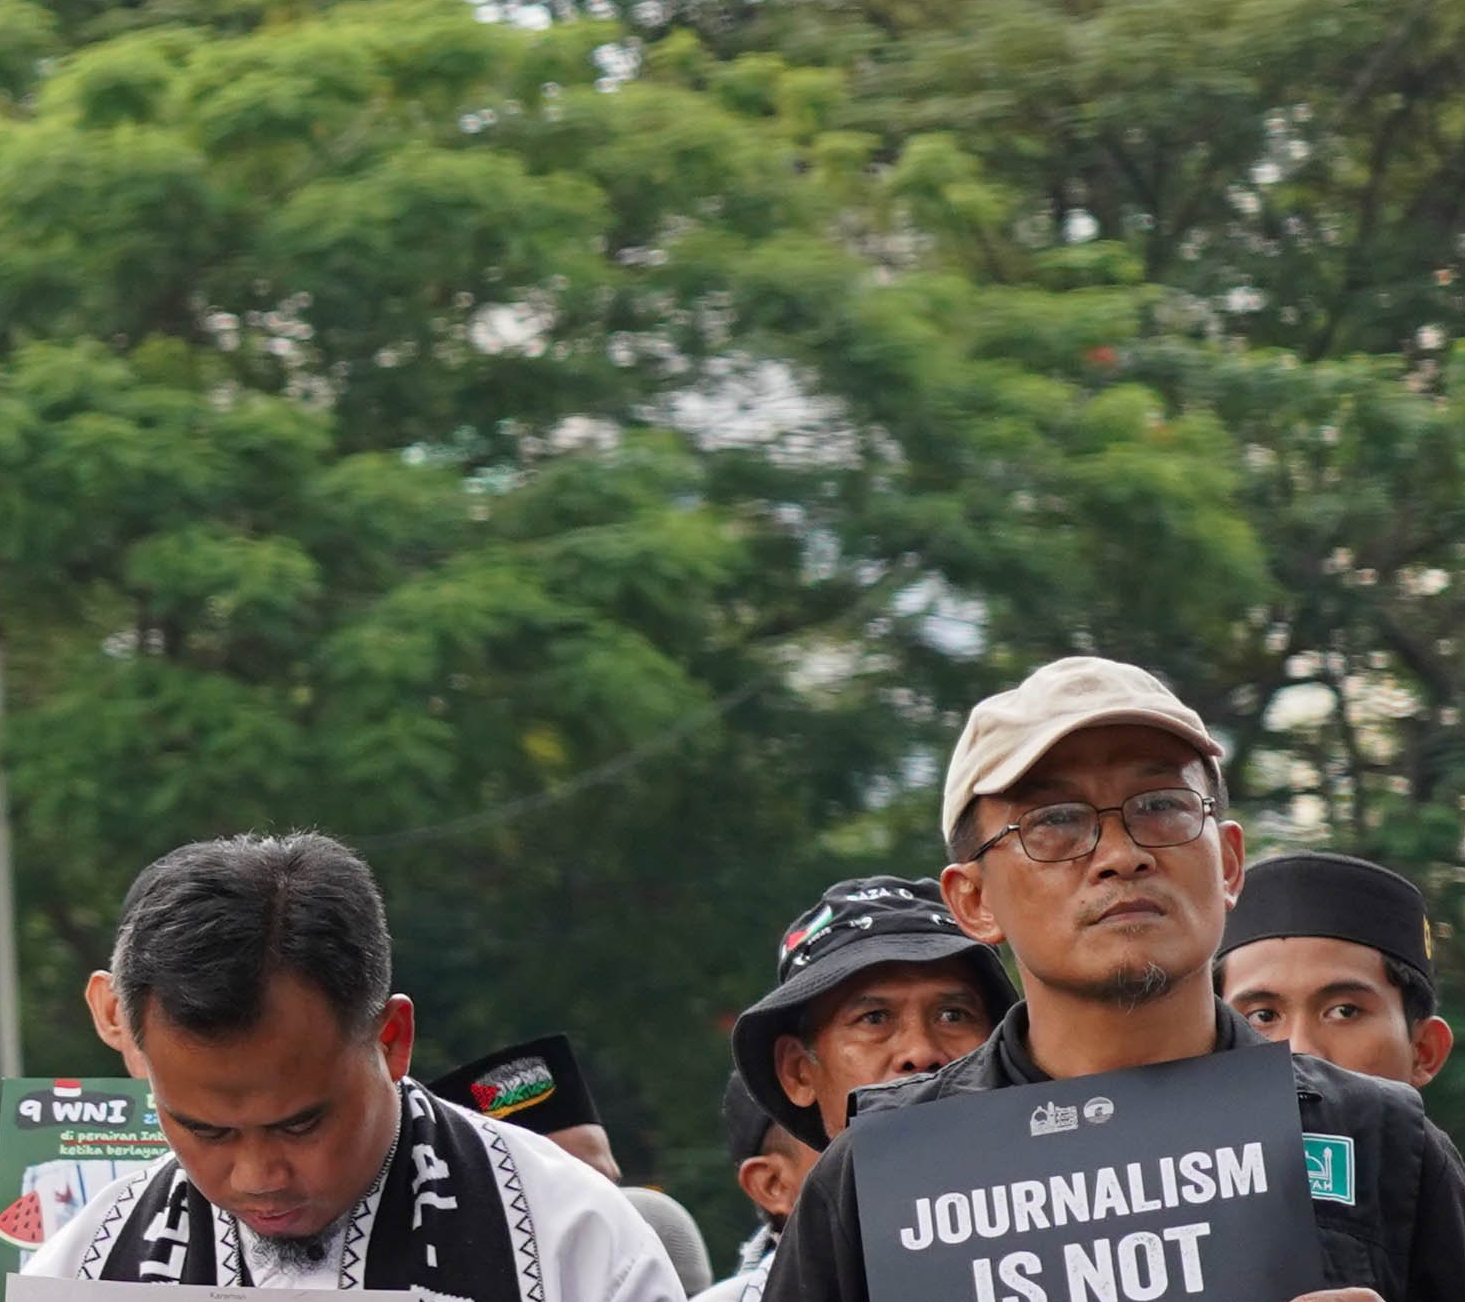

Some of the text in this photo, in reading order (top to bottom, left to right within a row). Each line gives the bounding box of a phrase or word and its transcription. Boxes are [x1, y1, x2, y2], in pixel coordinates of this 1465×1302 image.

[19, 1099, 42, 1123] 9
[52, 1100, 128, 1124] WNI
[60, 1131, 137, 1143] di perairan
[60, 1144, 166, 1158] ketika berlayar
[900, 1142, 1268, 1251] JOURNALISM
